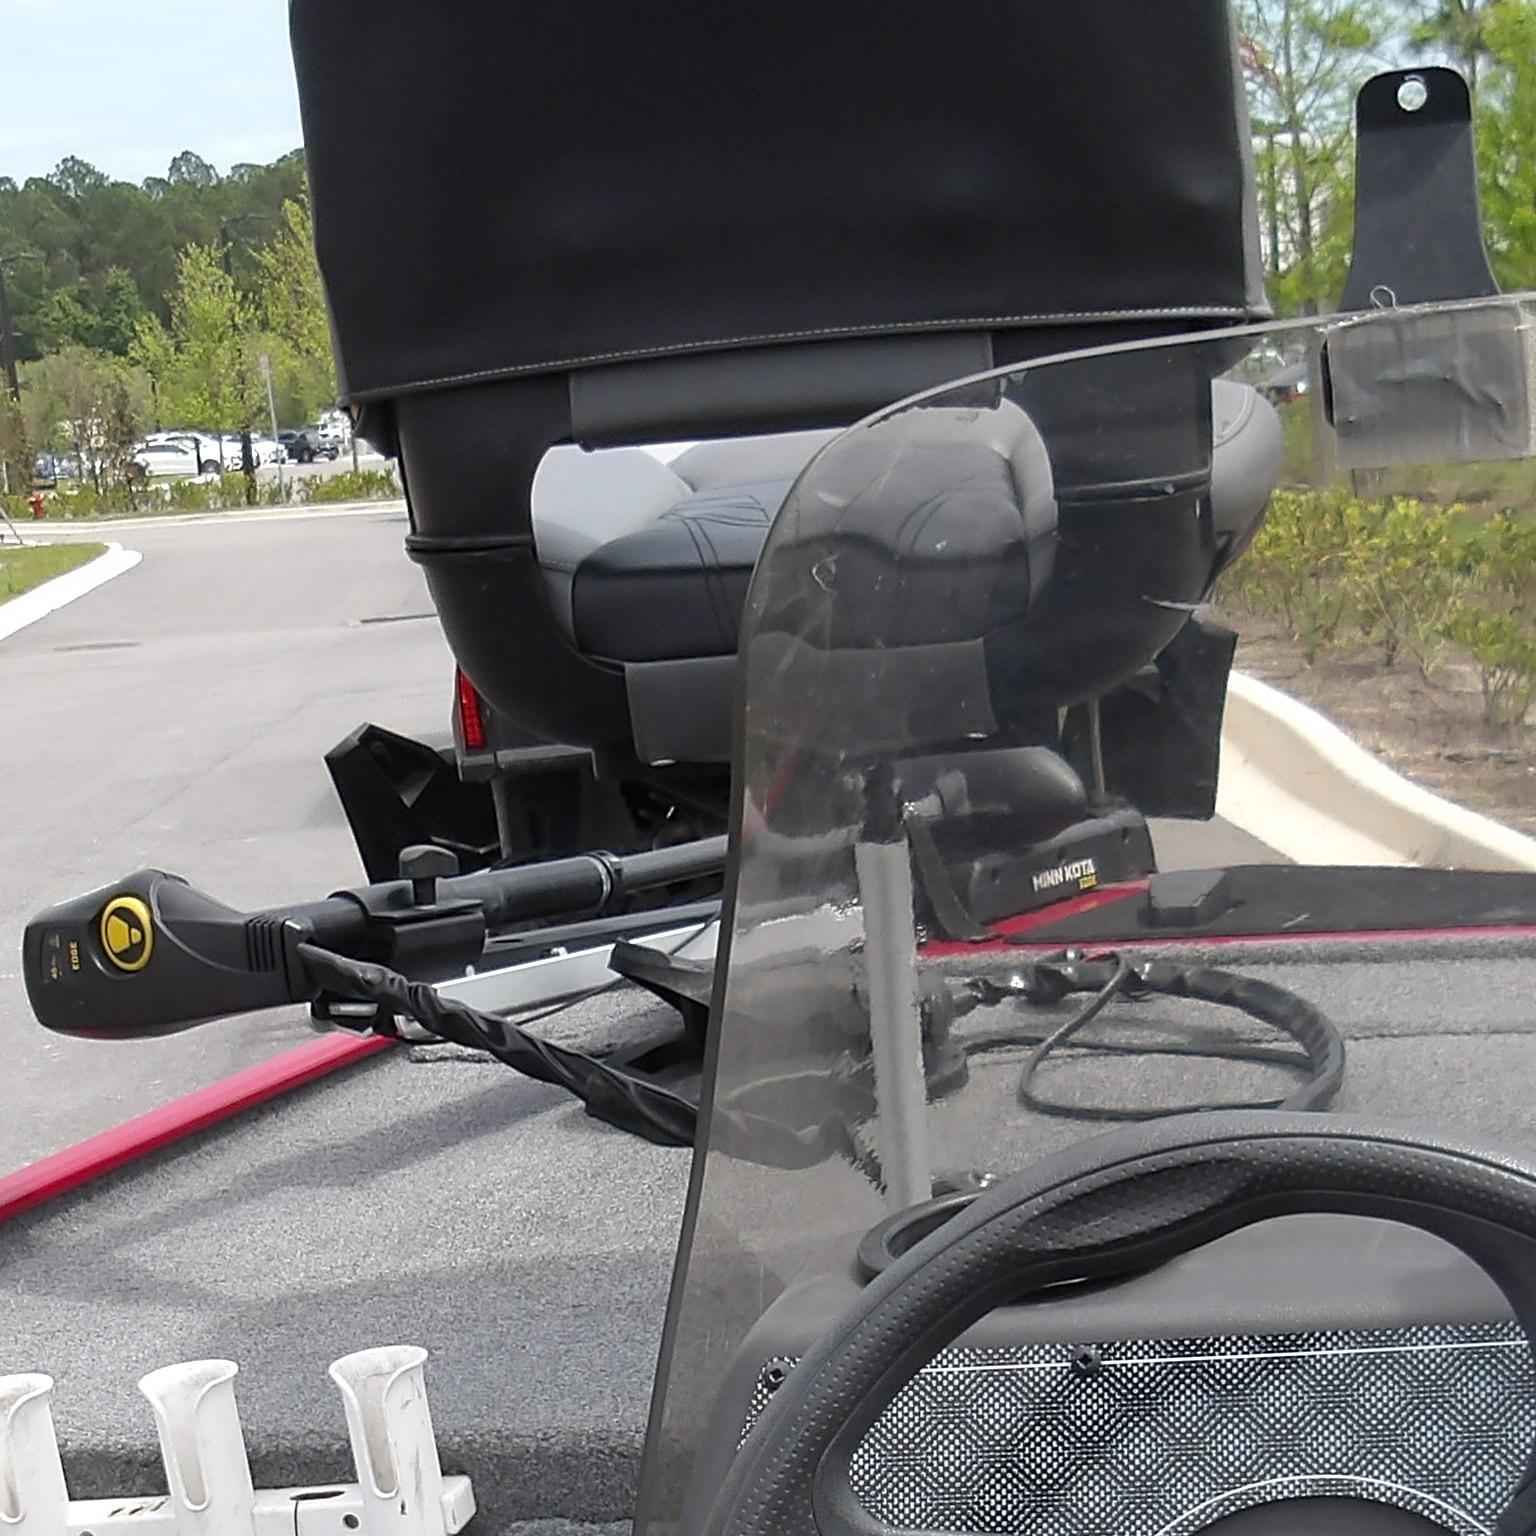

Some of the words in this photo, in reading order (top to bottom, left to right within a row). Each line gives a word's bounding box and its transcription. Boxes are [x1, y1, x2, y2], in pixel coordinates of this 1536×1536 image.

[1032, 867, 1064, 892] MINN
[1064, 858, 1096, 882] KOTA
[68, 941, 81, 971] EDGE
